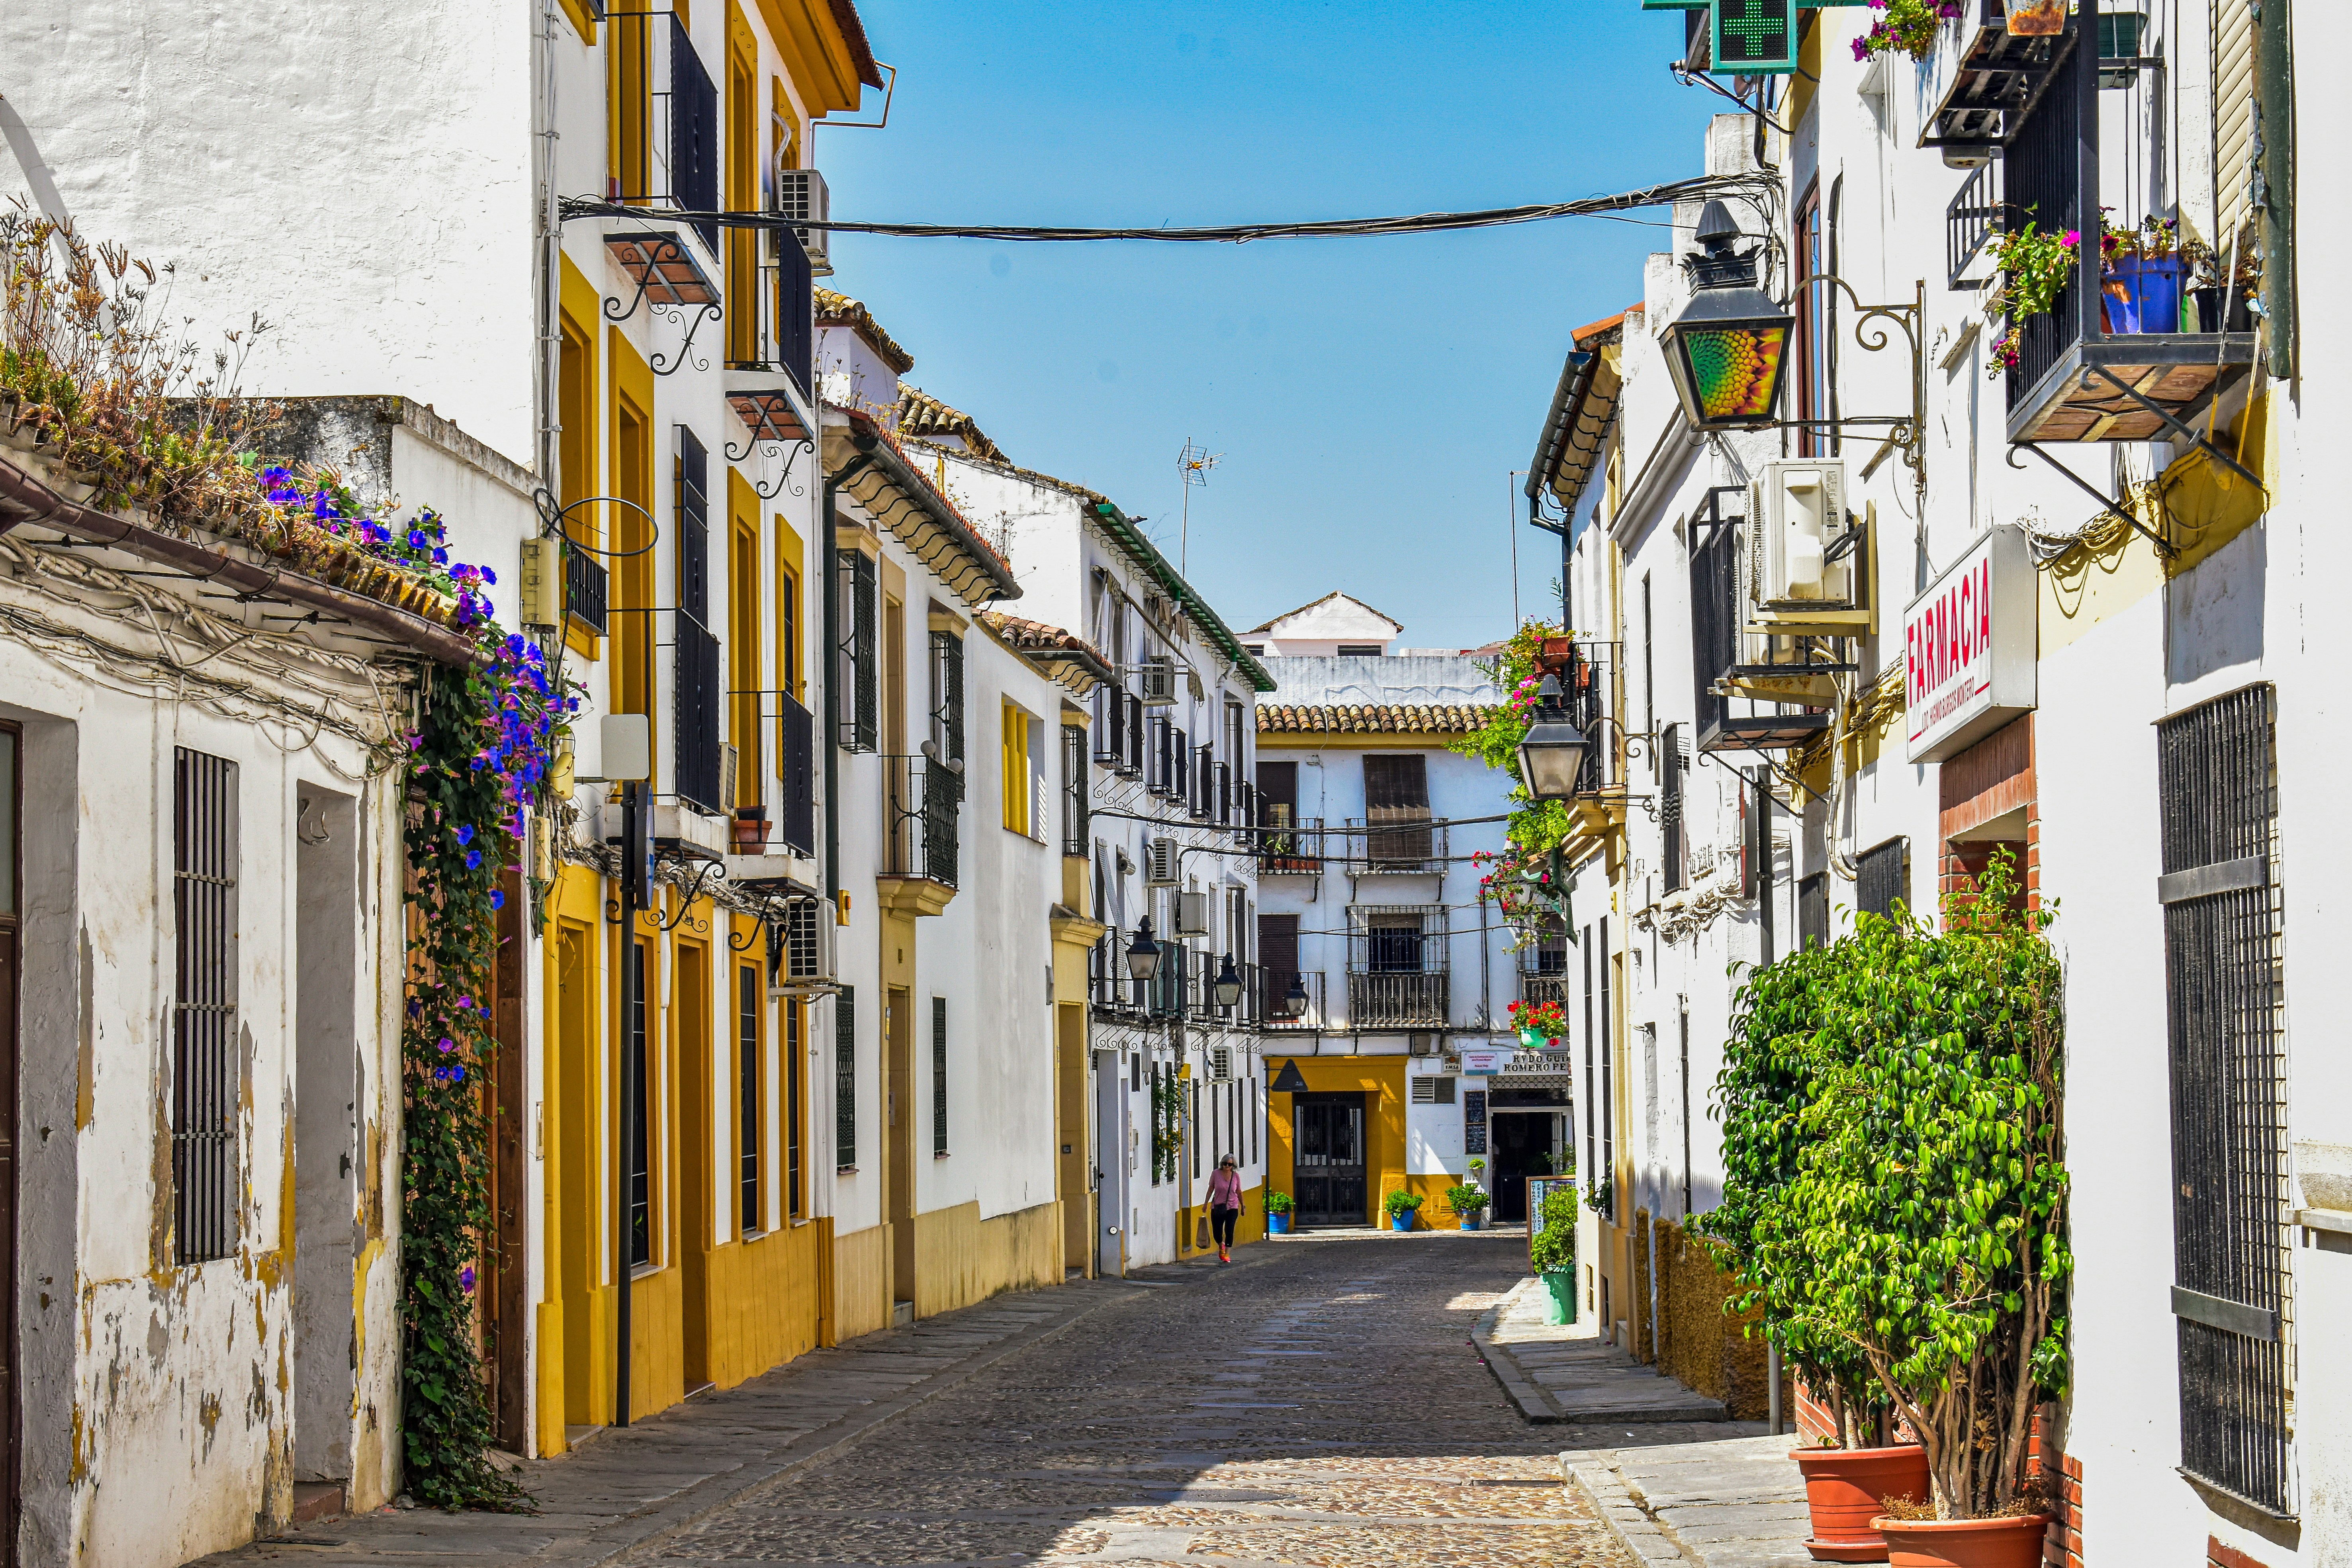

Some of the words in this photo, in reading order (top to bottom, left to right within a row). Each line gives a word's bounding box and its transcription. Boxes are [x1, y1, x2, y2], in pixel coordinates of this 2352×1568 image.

[1907, 557, 1990, 708] FARMACIA
[1942, 689, 1956, 718] BURGOS
[1957, 676, 1974, 708] MONTERO
[1504, 1063, 1549, 1071] ROMERO
